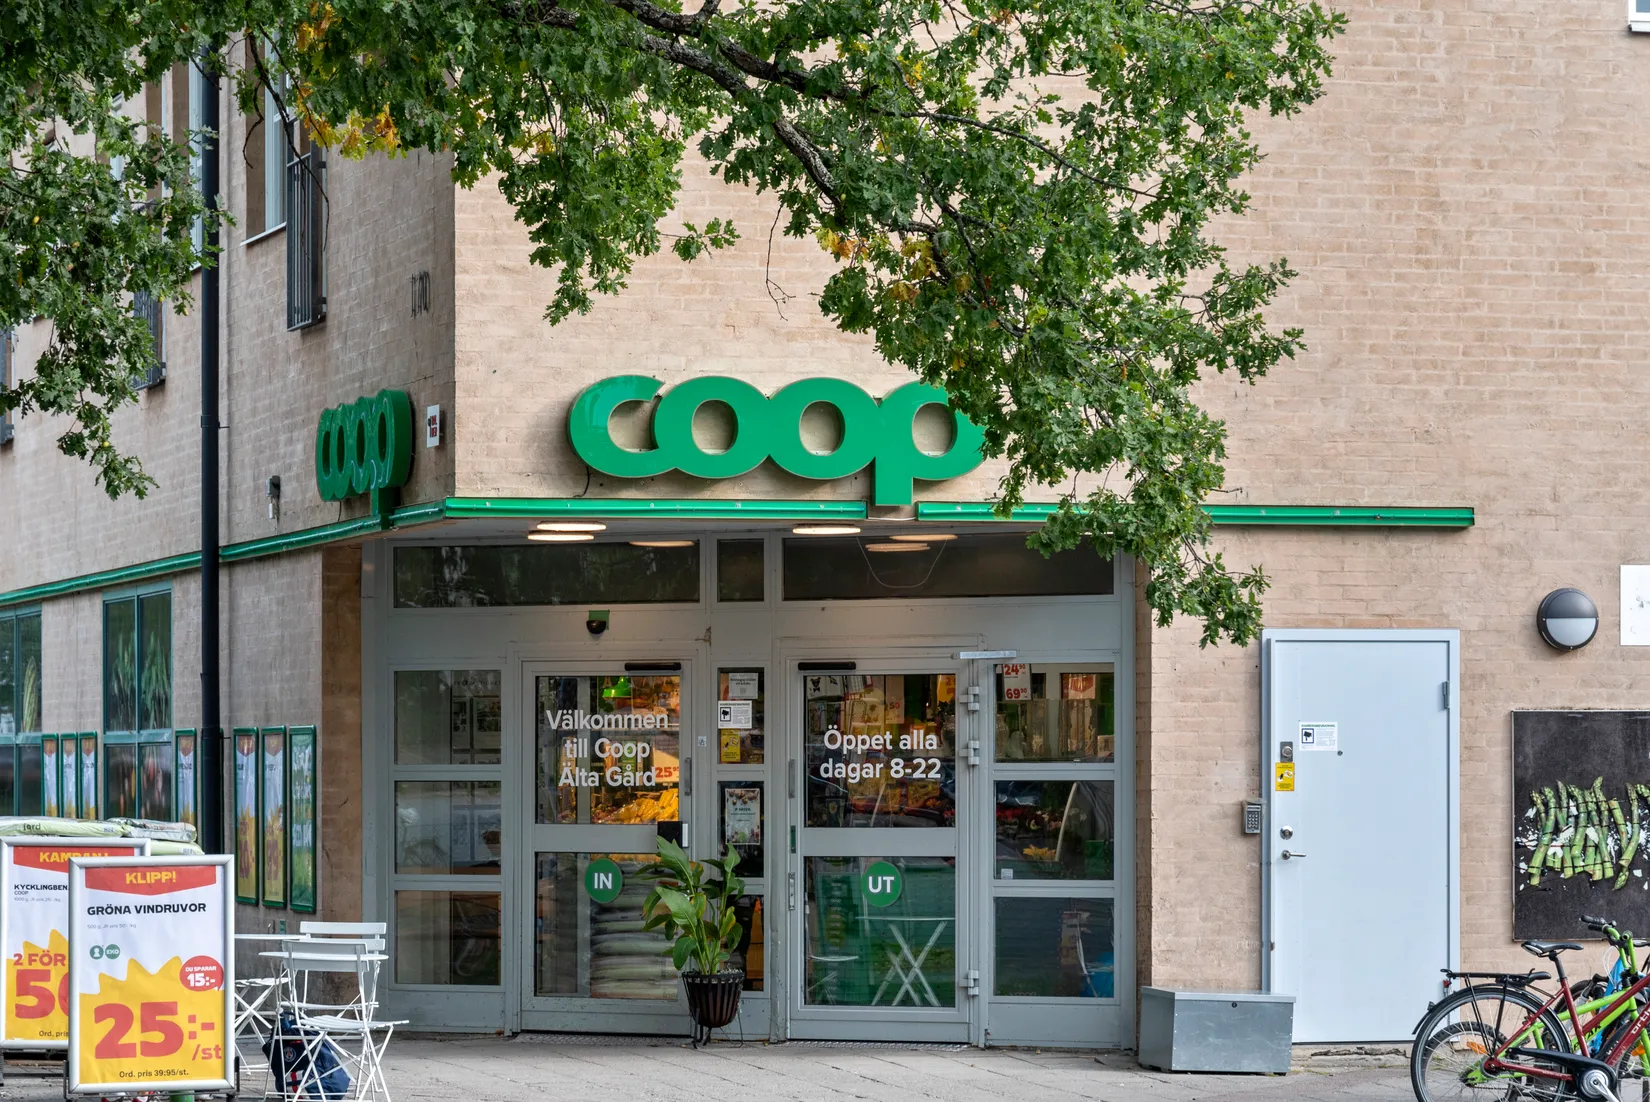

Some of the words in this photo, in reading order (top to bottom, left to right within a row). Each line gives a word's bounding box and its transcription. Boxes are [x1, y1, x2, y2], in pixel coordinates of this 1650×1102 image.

[568, 374, 987, 506] coop
[316, 388, 403, 518] coop
[546, 709, 669, 730] Välkommen
[823, 724, 893, 755] Öppet
[899, 729, 938, 750] alla
[565, 738, 588, 758] till
[594, 737, 650, 763] Coop
[558, 761, 600, 787] Älta
[606, 763, 656, 787] Gård
[819, 757, 884, 783] dagar
[890, 757, 942, 779] 8-22
[125, 871, 177, 885] KLIPP!
[594, 872, 612, 889] IN
[868, 876, 895, 893] UT
[87, 903, 132, 916] GRÖNA
[134, 903, 207, 914] VINDRUVOR
[13, 953, 23, 967] 2
[28, 949, 66, 967] FÖR
[187, 972, 216, 987] 15:-
[93, 1001, 215, 1059] 25:-
[191, 1044, 222, 1061] /st
[137, 1070, 152, 1078] pris
[154, 1068, 189, 1077] 39:95/st.
